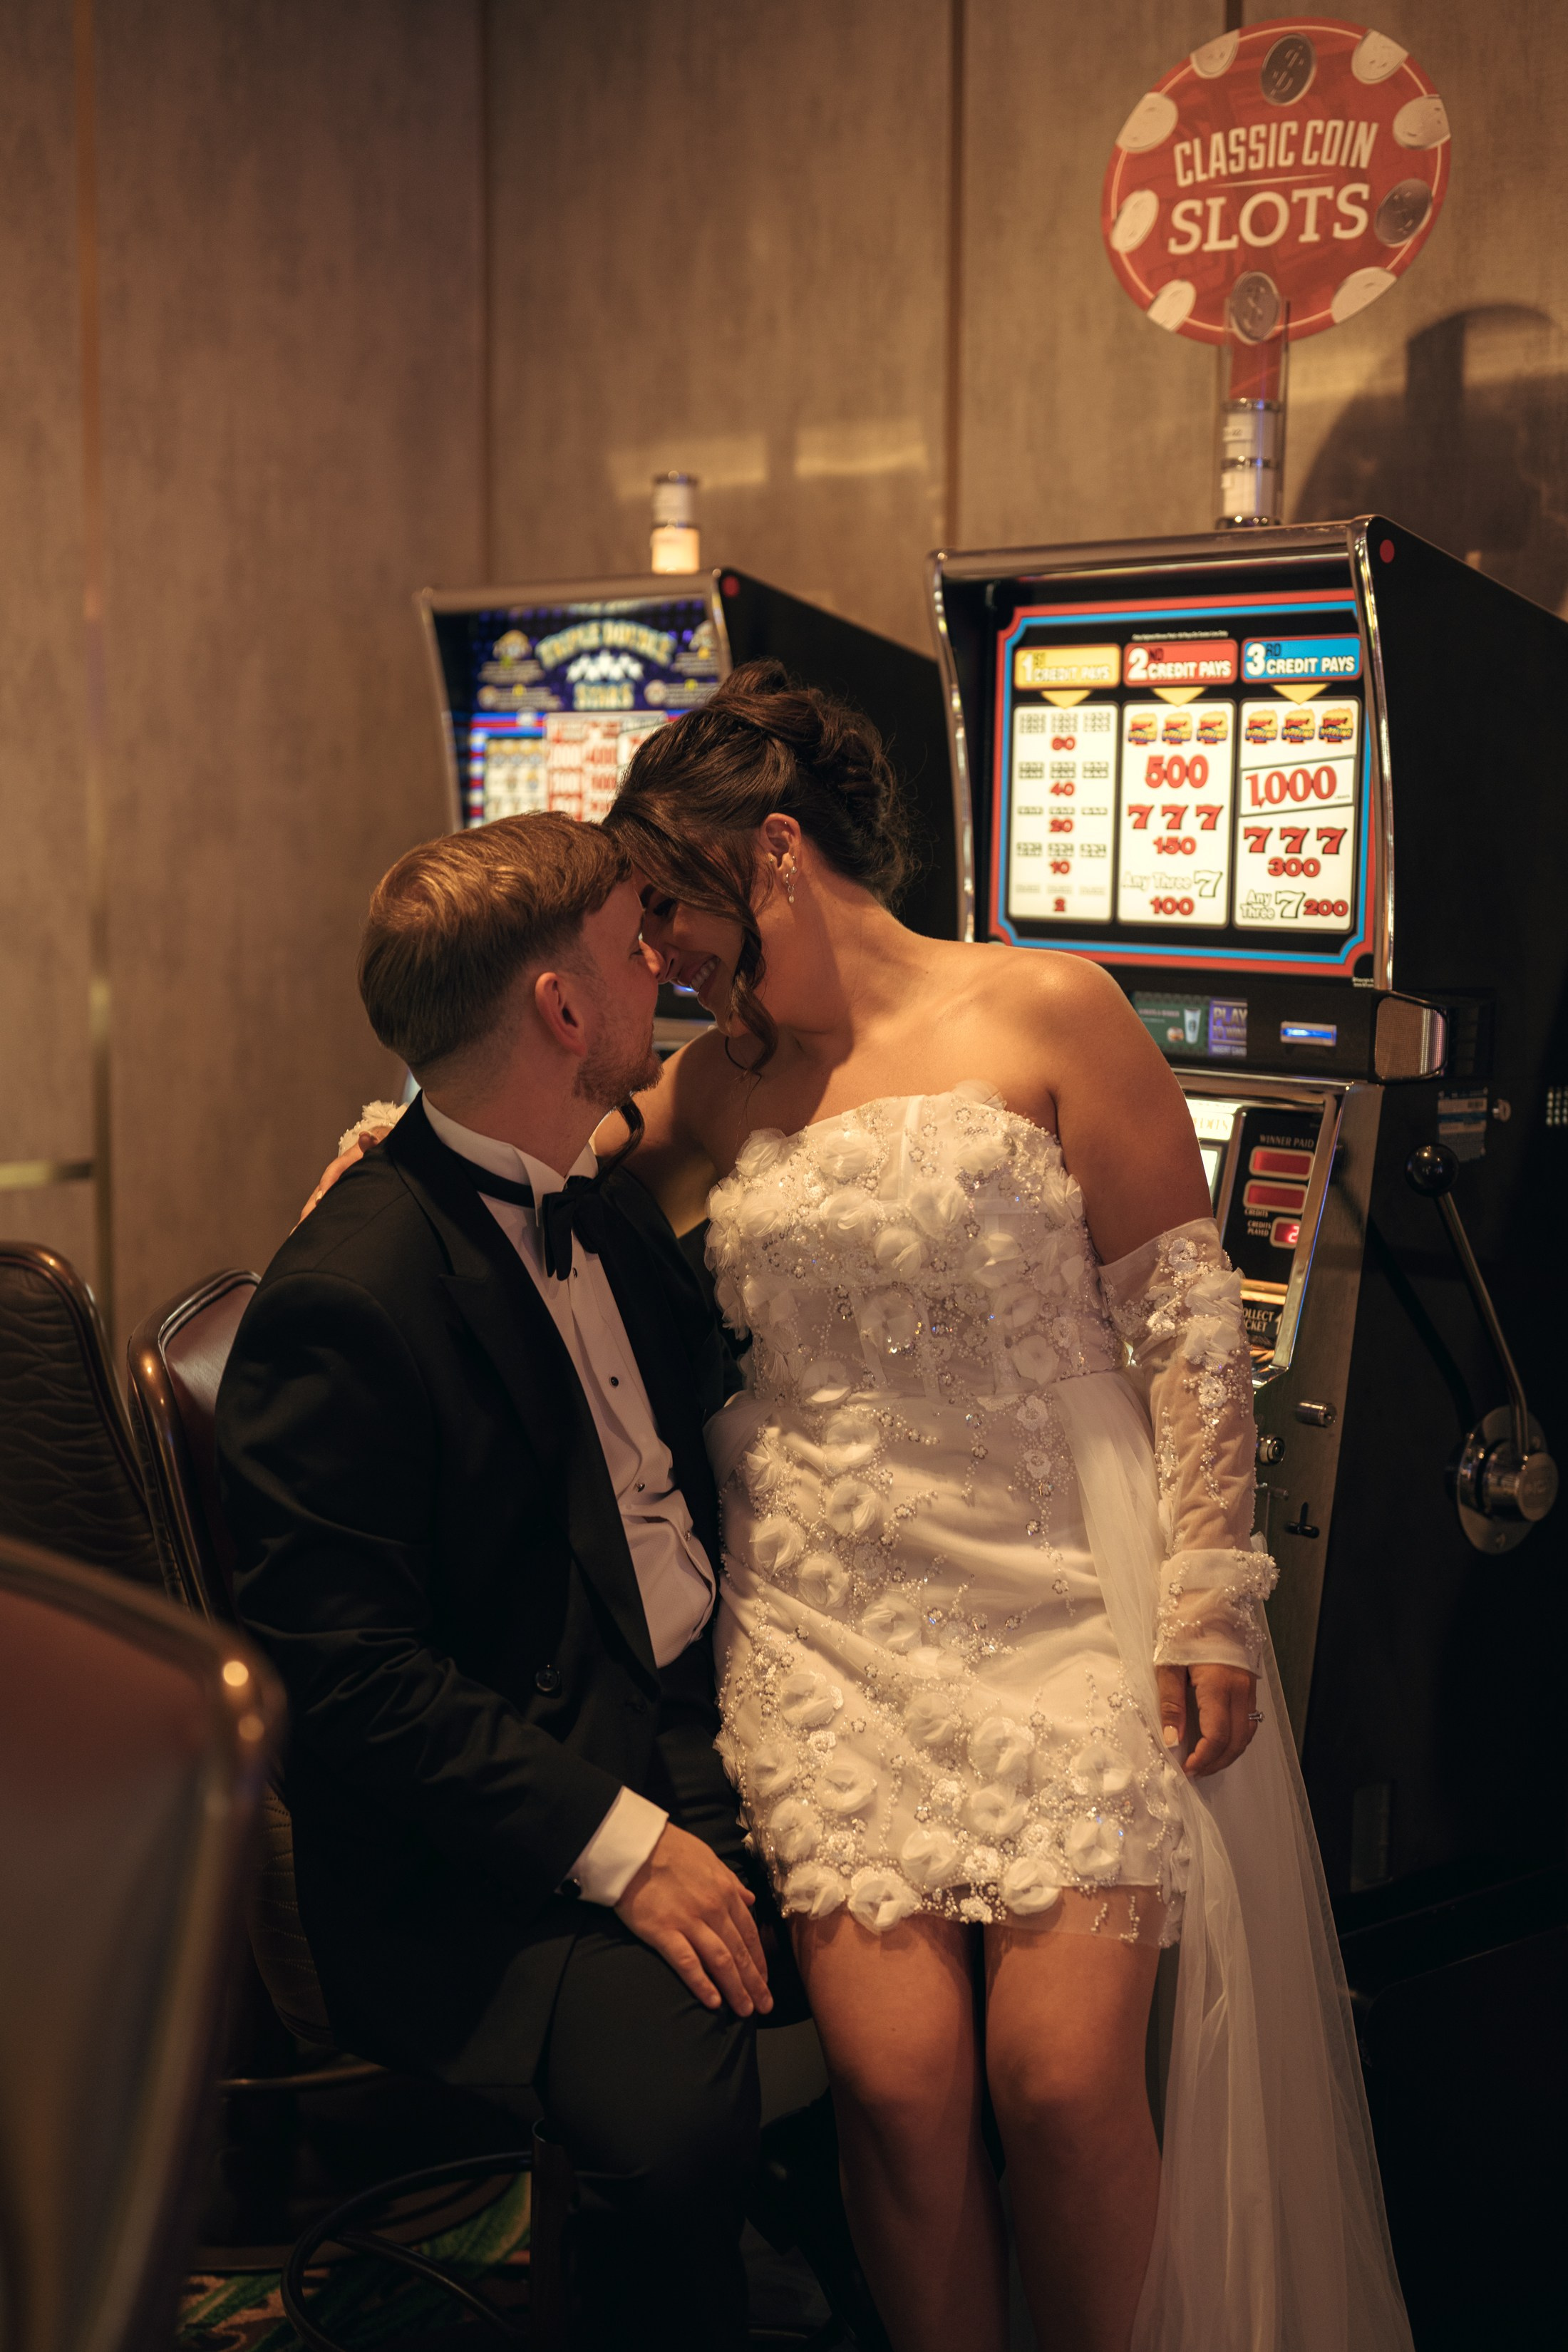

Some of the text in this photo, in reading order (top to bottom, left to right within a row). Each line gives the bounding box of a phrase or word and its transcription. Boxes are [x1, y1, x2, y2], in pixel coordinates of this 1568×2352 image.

[1173, 119, 1379, 188] CLASSIC COIN
[1167, 182, 1371, 255] SLOTS
[1034, 667, 1078, 682] CREDIT
[1147, 662, 1197, 680] CREDIT
[1198, 660, 1232, 679] PAYS
[1266, 657, 1318, 675] CREDIT
[1321, 656, 1355, 674] PAYS
[1145, 754, 1209, 788] 500
[1050, 782, 1075, 796] 40
[1245, 765, 1337, 808] 1,000
[1128, 804, 1224, 830] 7 7 7
[1153, 836, 1196, 855] 150
[1244, 827, 1348, 855] 7 7 7
[1050, 860, 1071, 875] 10
[1268, 857, 1321, 877] 300
[1193, 870, 1223, 897] 7
[1150, 897, 1194, 916] 100
[1247, 889, 1272, 907] Any
[1275, 890, 1349, 919] 7 200
[1240, 903, 1275, 919] Three
[1213, 1006, 1248, 1027] PLAY
[1259, 1134, 1314, 1148] WINNER PAID
[1244, 1208, 1269, 1217] CREDITS
[1247, 1220, 1272, 1229] CREDITS
[1247, 1228, 1269, 1237] PLAYED
[1287, 1225, 1300, 1243] 2
[1243, 1307, 1274, 1322] OLLECT
